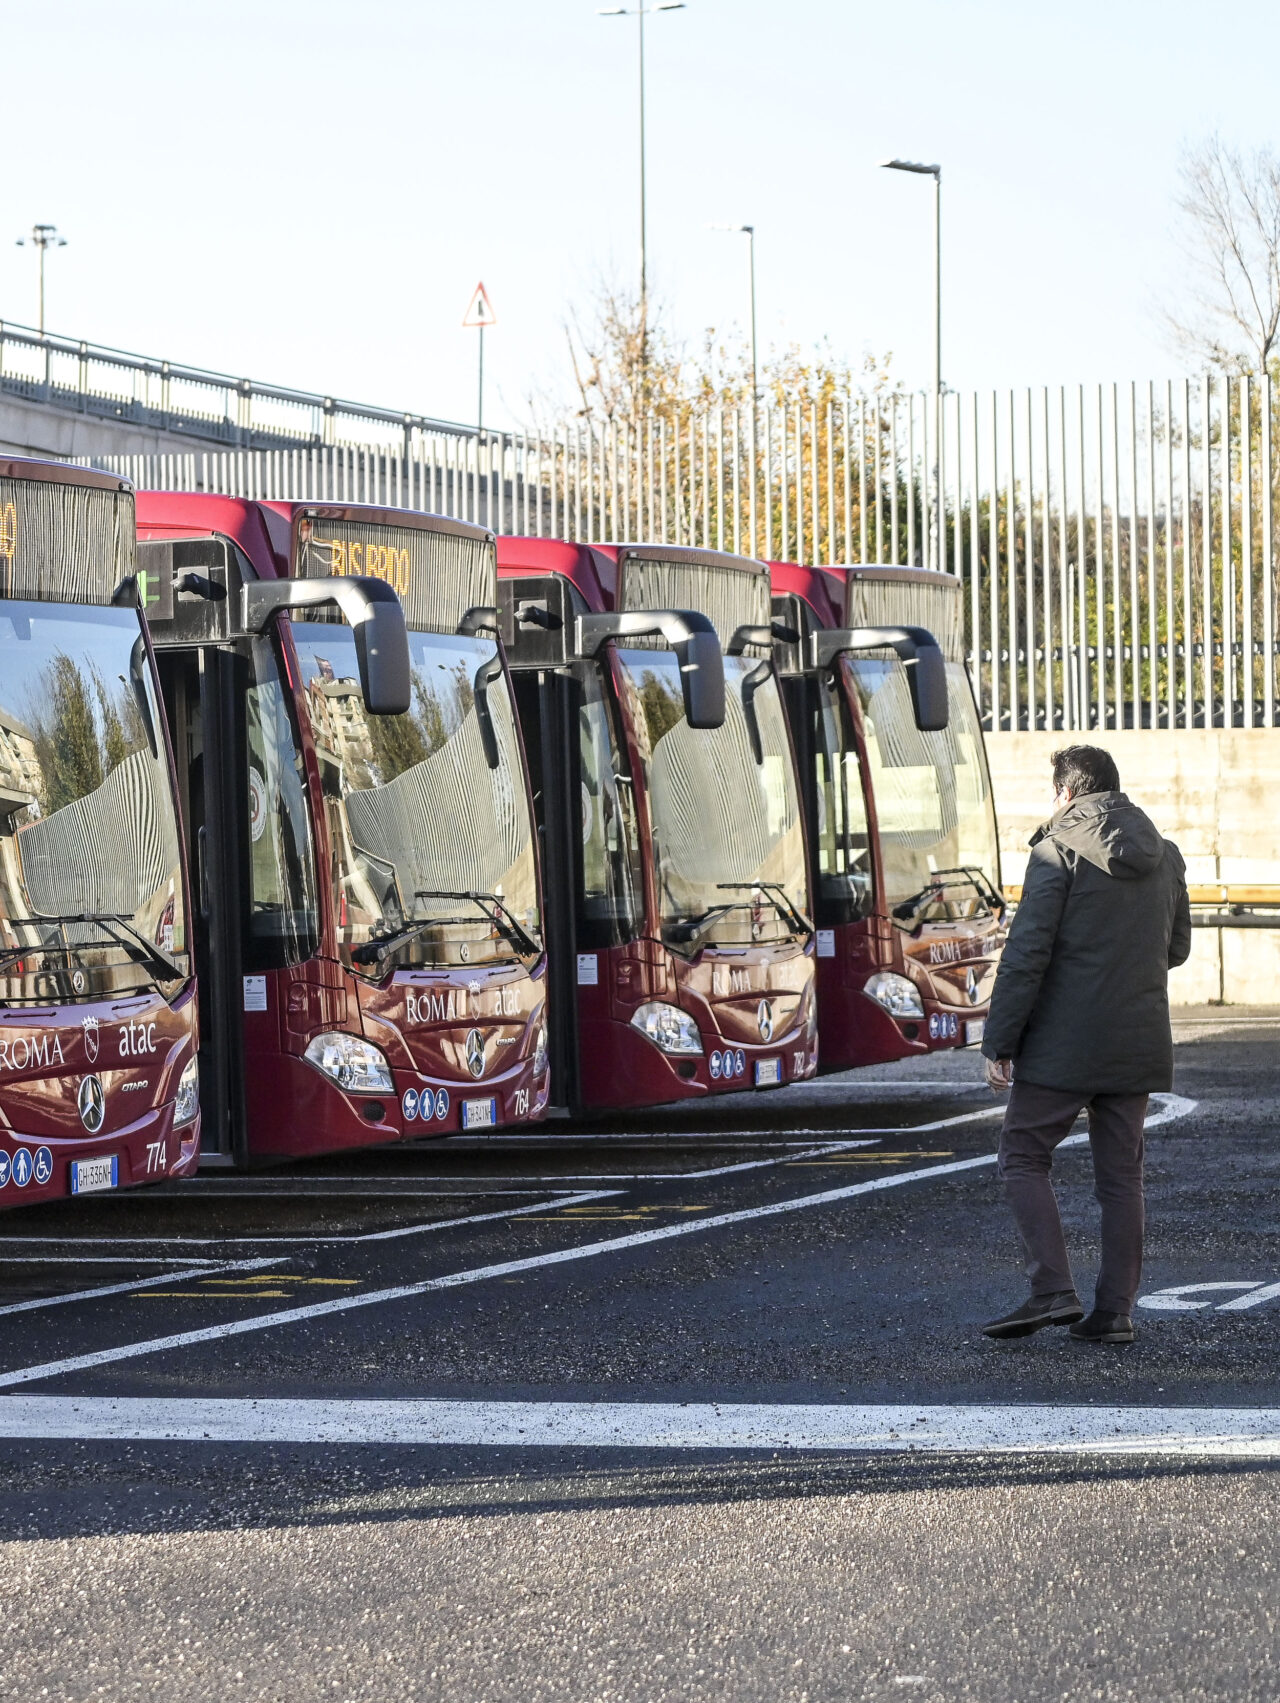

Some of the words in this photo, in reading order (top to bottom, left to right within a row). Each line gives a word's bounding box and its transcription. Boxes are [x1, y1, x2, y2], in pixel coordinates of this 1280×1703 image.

[331, 539, 362, 577] BUS
[930, 941, 961, 963] ROMA
[406, 993, 457, 1023] ROMA
[494, 985, 522, 1016] atac
[118, 1019, 157, 1057] atac
[514, 1088, 530, 1116] 764
[146, 1140, 166, 1174] 774
